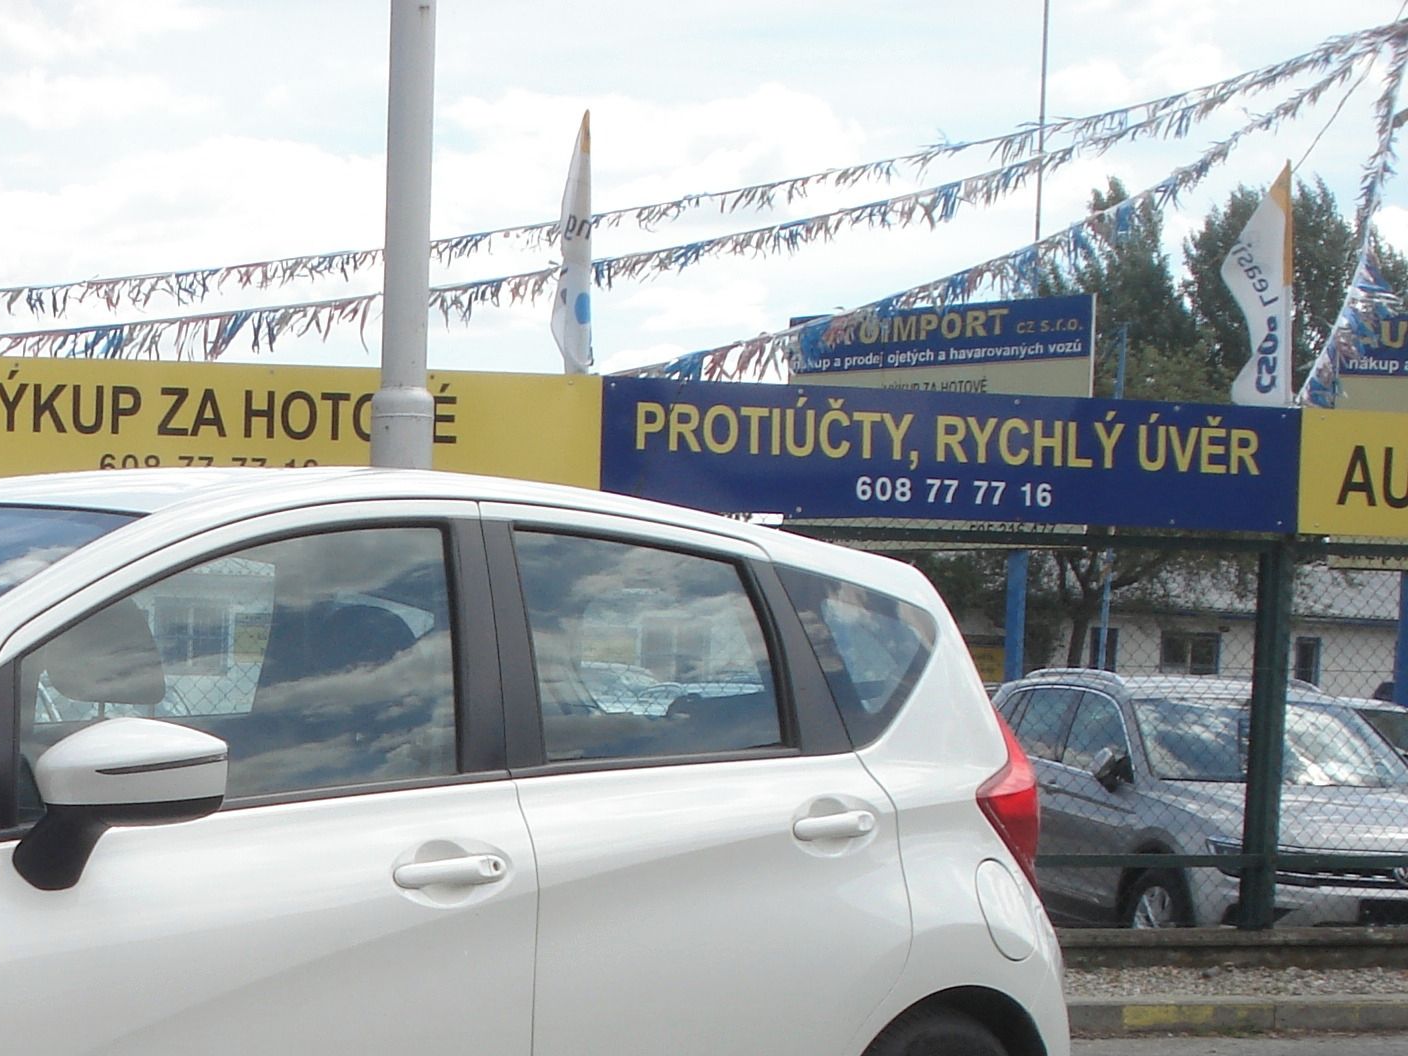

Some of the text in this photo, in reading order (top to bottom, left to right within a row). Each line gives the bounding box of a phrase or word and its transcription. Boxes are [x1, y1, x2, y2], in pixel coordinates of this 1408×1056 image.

[1040, 317, 1084, 333] s.r.o.
[834, 356, 841, 367] a
[844, 350, 884, 370] prodej
[887, 347, 935, 368] ojetých
[937, 350, 946, 361] a
[949, 340, 1043, 360] havarovaných
[1349, 356, 1400, 374] nákup
[157, 387, 227, 437] ZA
[243, 383, 458, 444] HOTOÉ
[635, 396, 1260, 476] PROTIÚČTY, RYCHLÝ ÚVĚR
[856, 475, 1053, 508] 608 77 77 16
